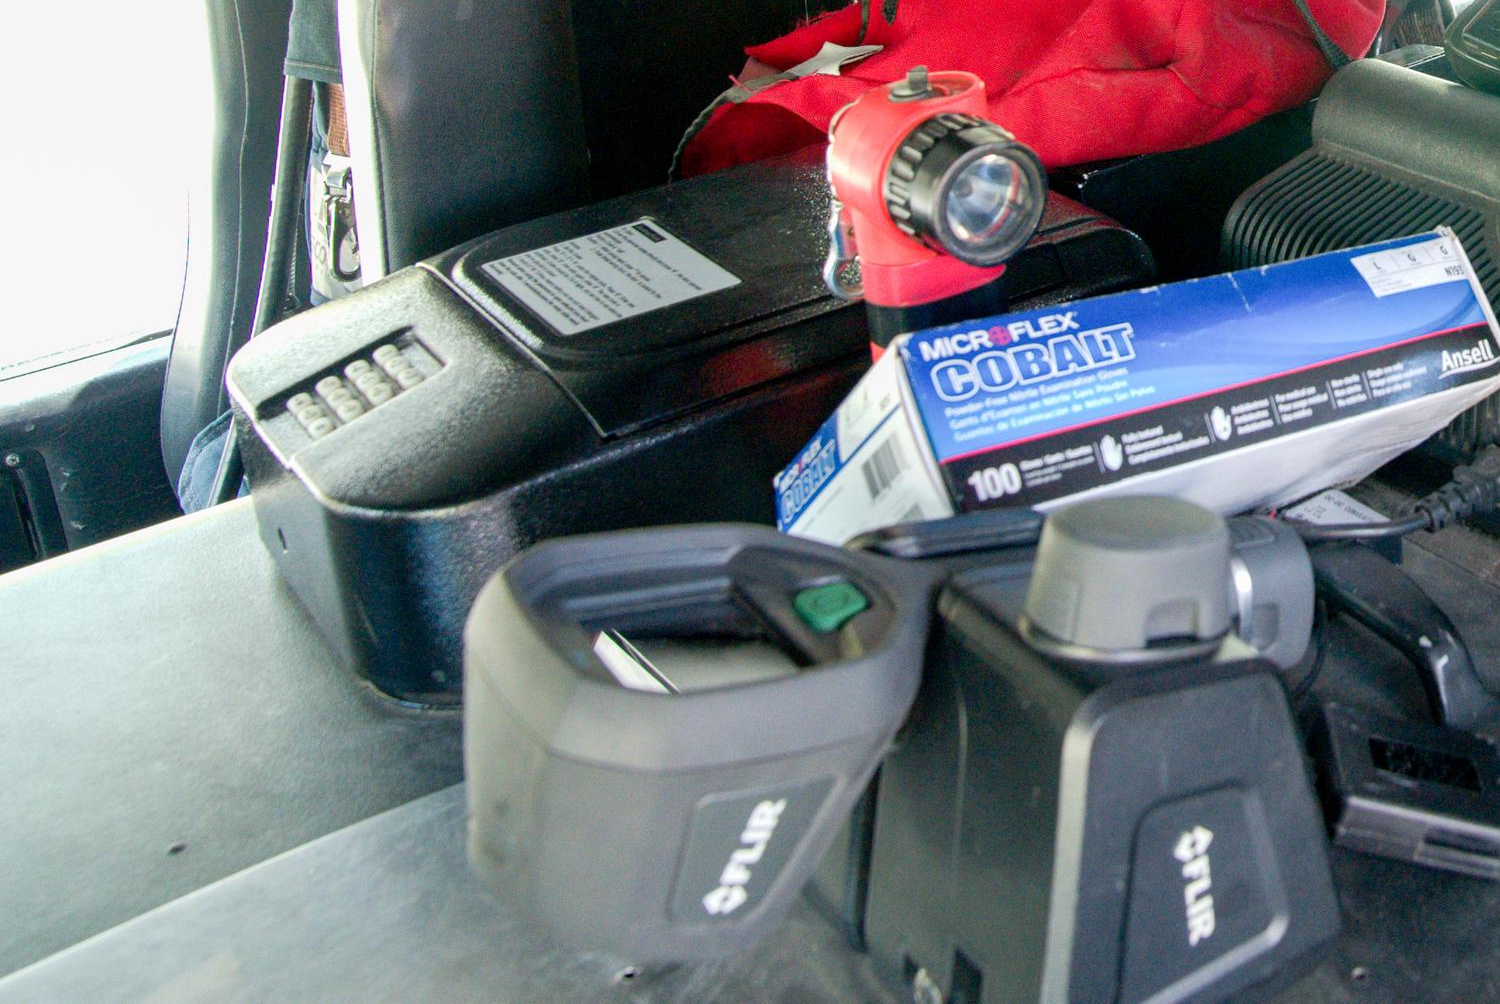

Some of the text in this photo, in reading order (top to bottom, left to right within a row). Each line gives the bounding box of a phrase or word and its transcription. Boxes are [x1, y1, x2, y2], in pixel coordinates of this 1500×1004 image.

[1440, 245, 1448, 255] G
[918, 312, 1080, 362] MICROFLEX
[930, 322, 1136, 402] COBALT
[1441, 339, 1495, 372] Ansell
[968, 462, 1022, 502] 100
[719, 798, 787, 885] FLIR
[1182, 854, 1215, 947] FLIR
